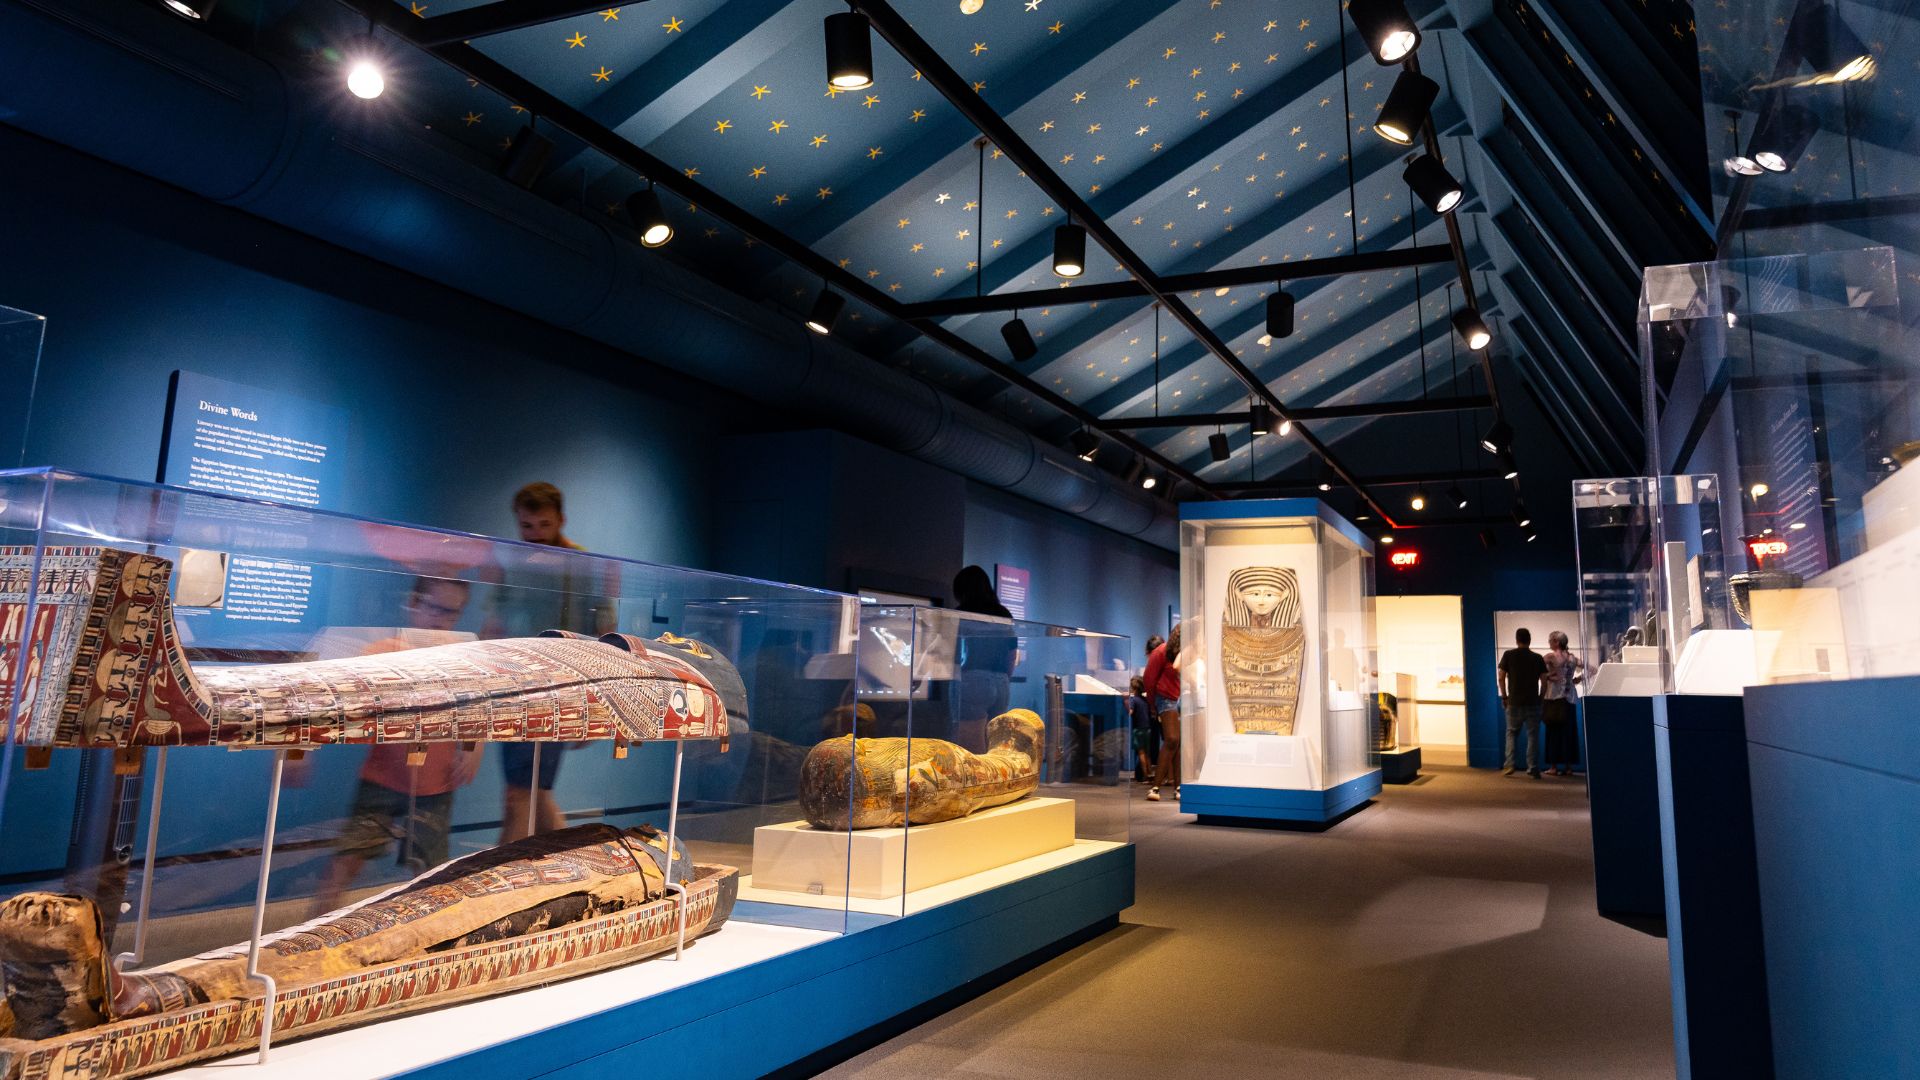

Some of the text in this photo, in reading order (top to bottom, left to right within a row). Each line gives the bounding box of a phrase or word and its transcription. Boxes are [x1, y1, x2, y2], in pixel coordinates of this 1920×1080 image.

[199, 400, 258, 421] Divine Words
[1396, 553, 1417, 564] EXIT
